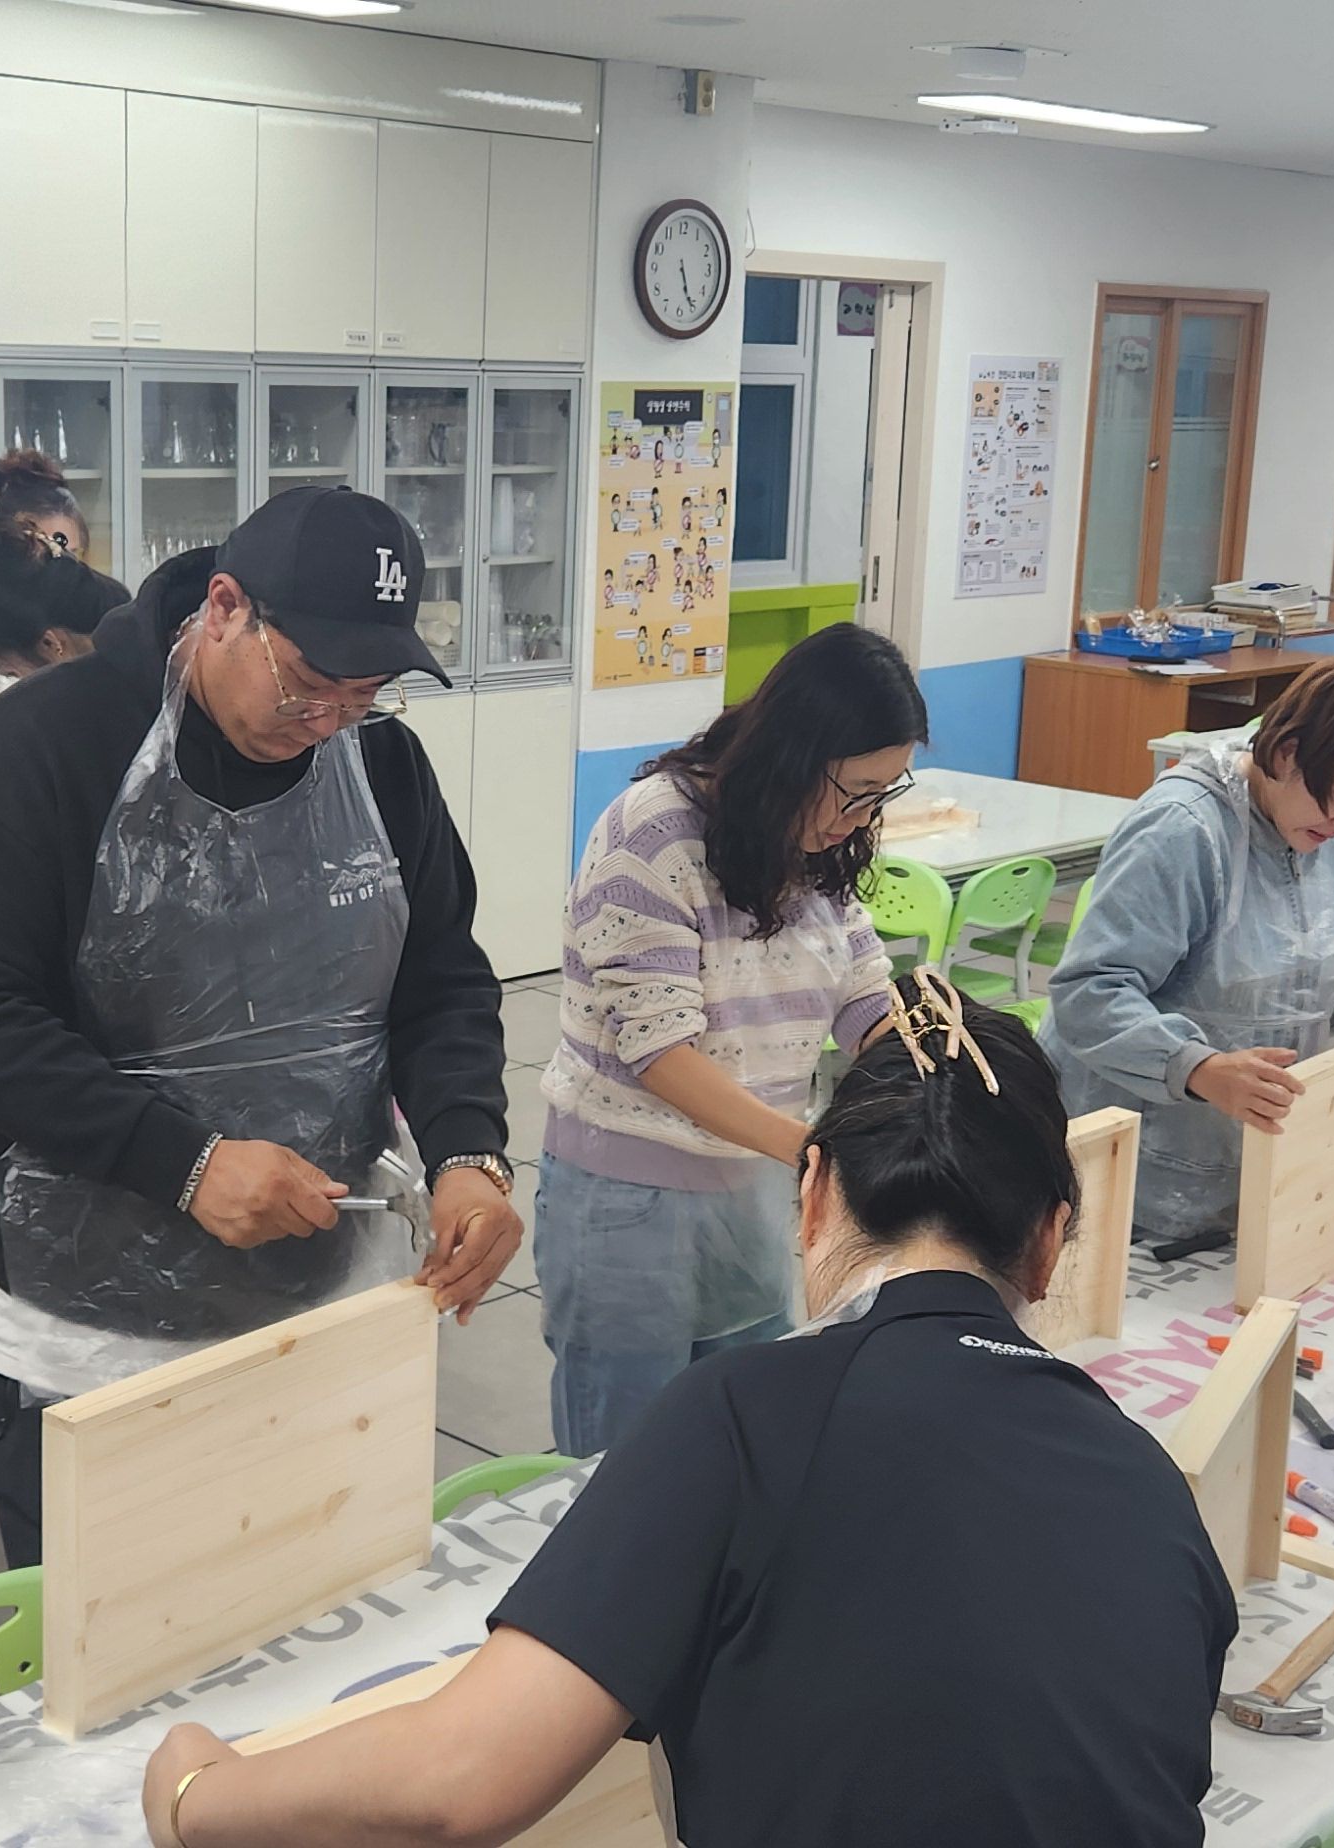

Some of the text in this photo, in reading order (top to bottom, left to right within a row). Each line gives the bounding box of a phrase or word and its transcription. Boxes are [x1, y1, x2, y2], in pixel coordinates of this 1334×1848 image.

[665, 226, 673, 241] 11
[679, 221, 689, 235] 12
[695, 228, 700, 241] 1
[654, 242, 665, 256] 10
[703, 244, 710, 258] 2
[651, 261, 658, 274] 9
[704, 263, 712, 278] 3
[653, 282, 661, 296] 8
[676, 304, 684, 317] 6
[374, 547, 407, 602] LA
